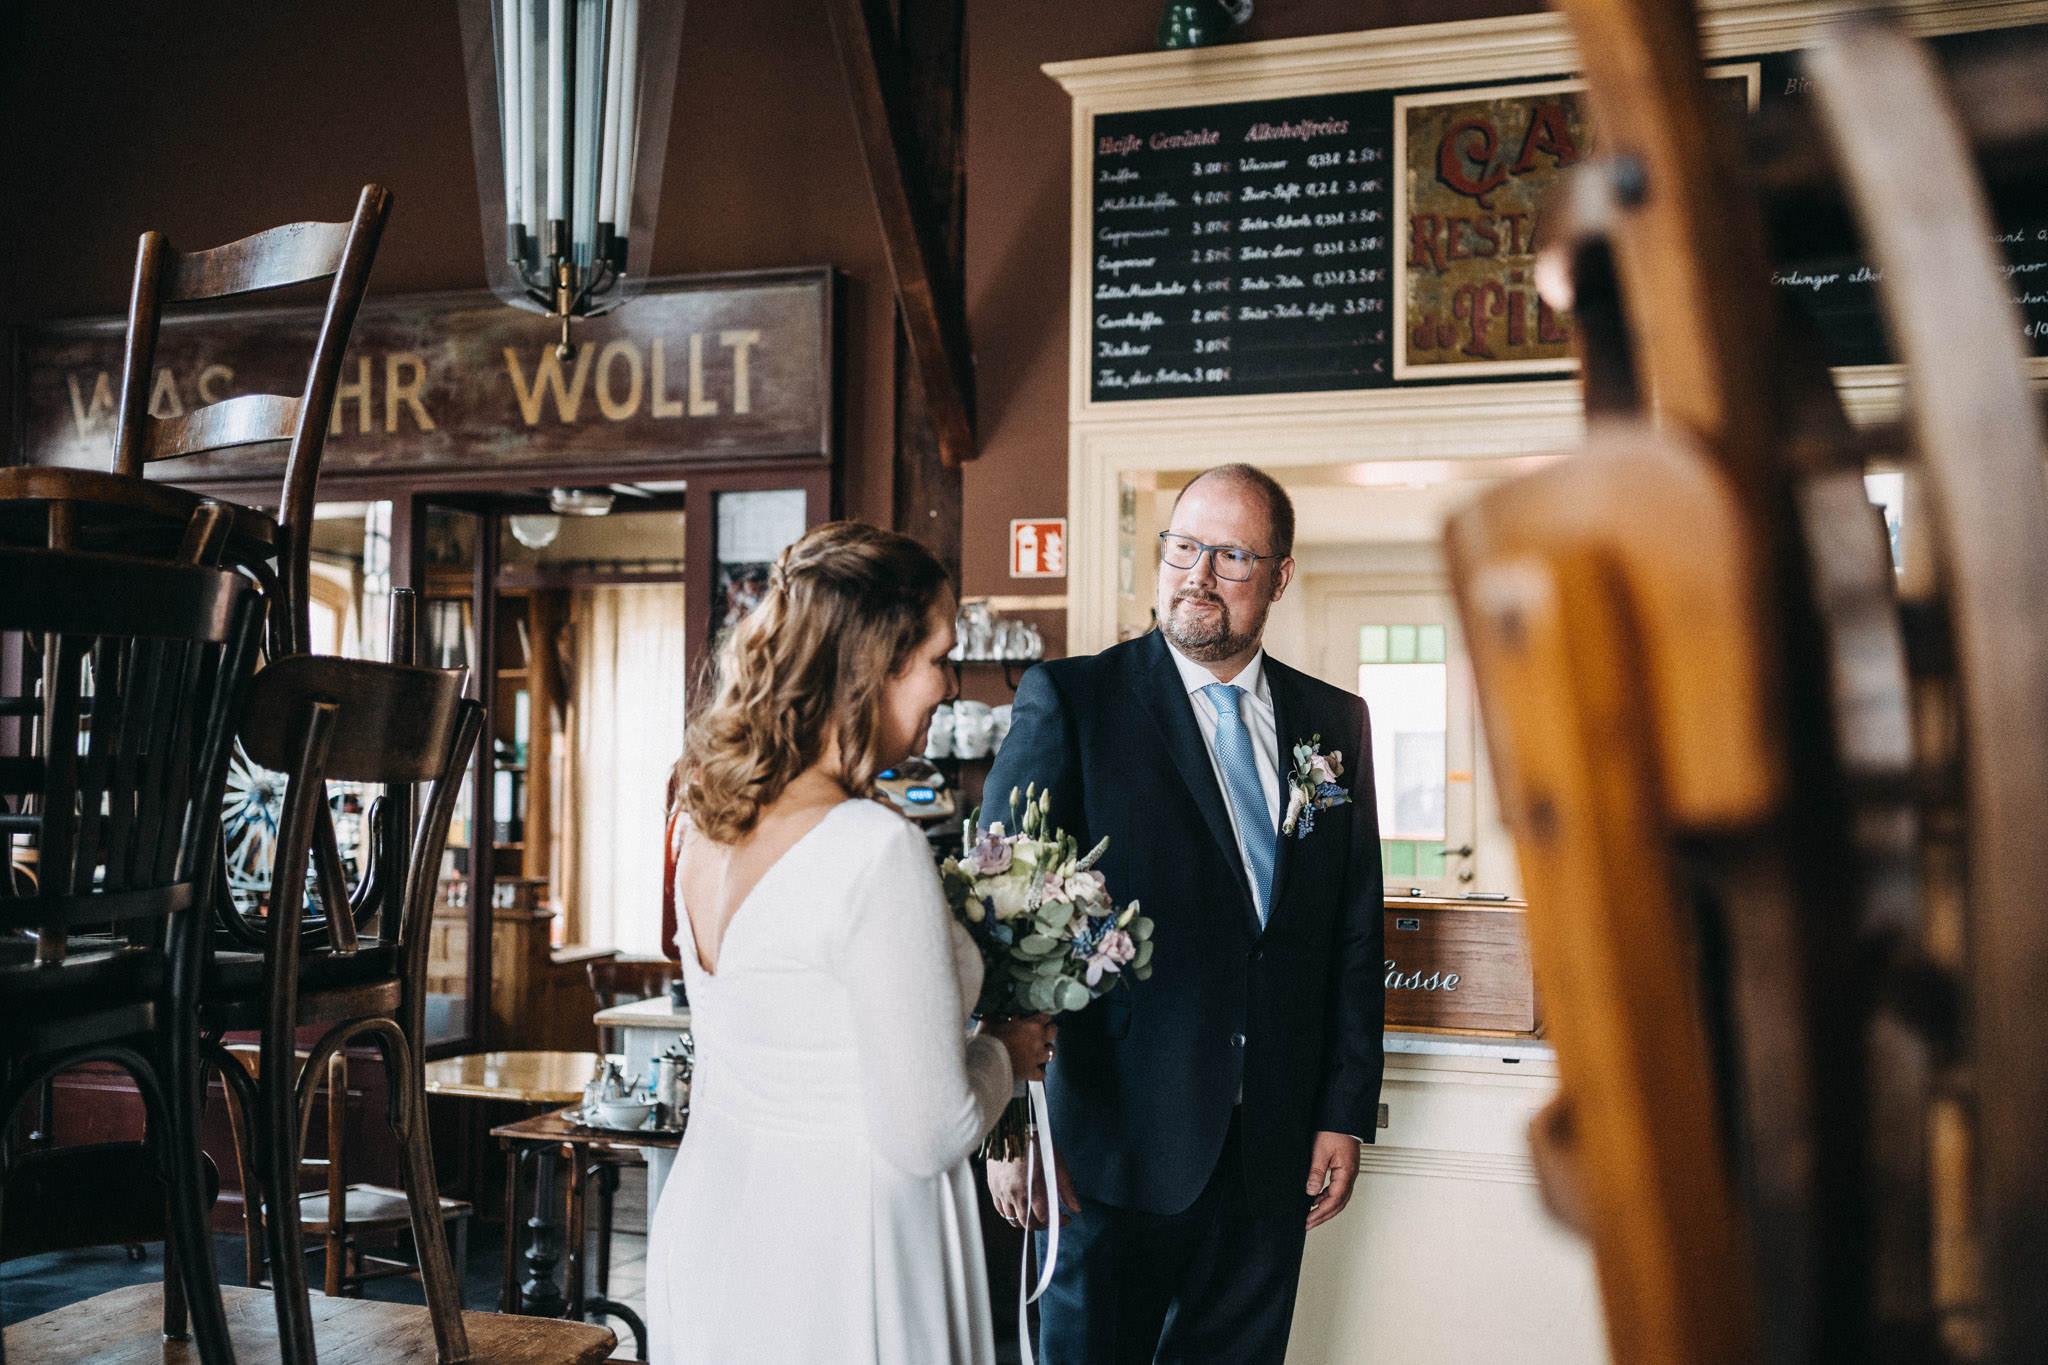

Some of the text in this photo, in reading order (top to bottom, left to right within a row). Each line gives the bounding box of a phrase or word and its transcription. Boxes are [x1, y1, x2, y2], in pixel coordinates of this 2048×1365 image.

[1436, 103, 1583, 209] CA
[1771, 270, 1839, 292] Erdinger
[330, 354, 436, 435] HR
[502, 328, 761, 426] WOLLT
